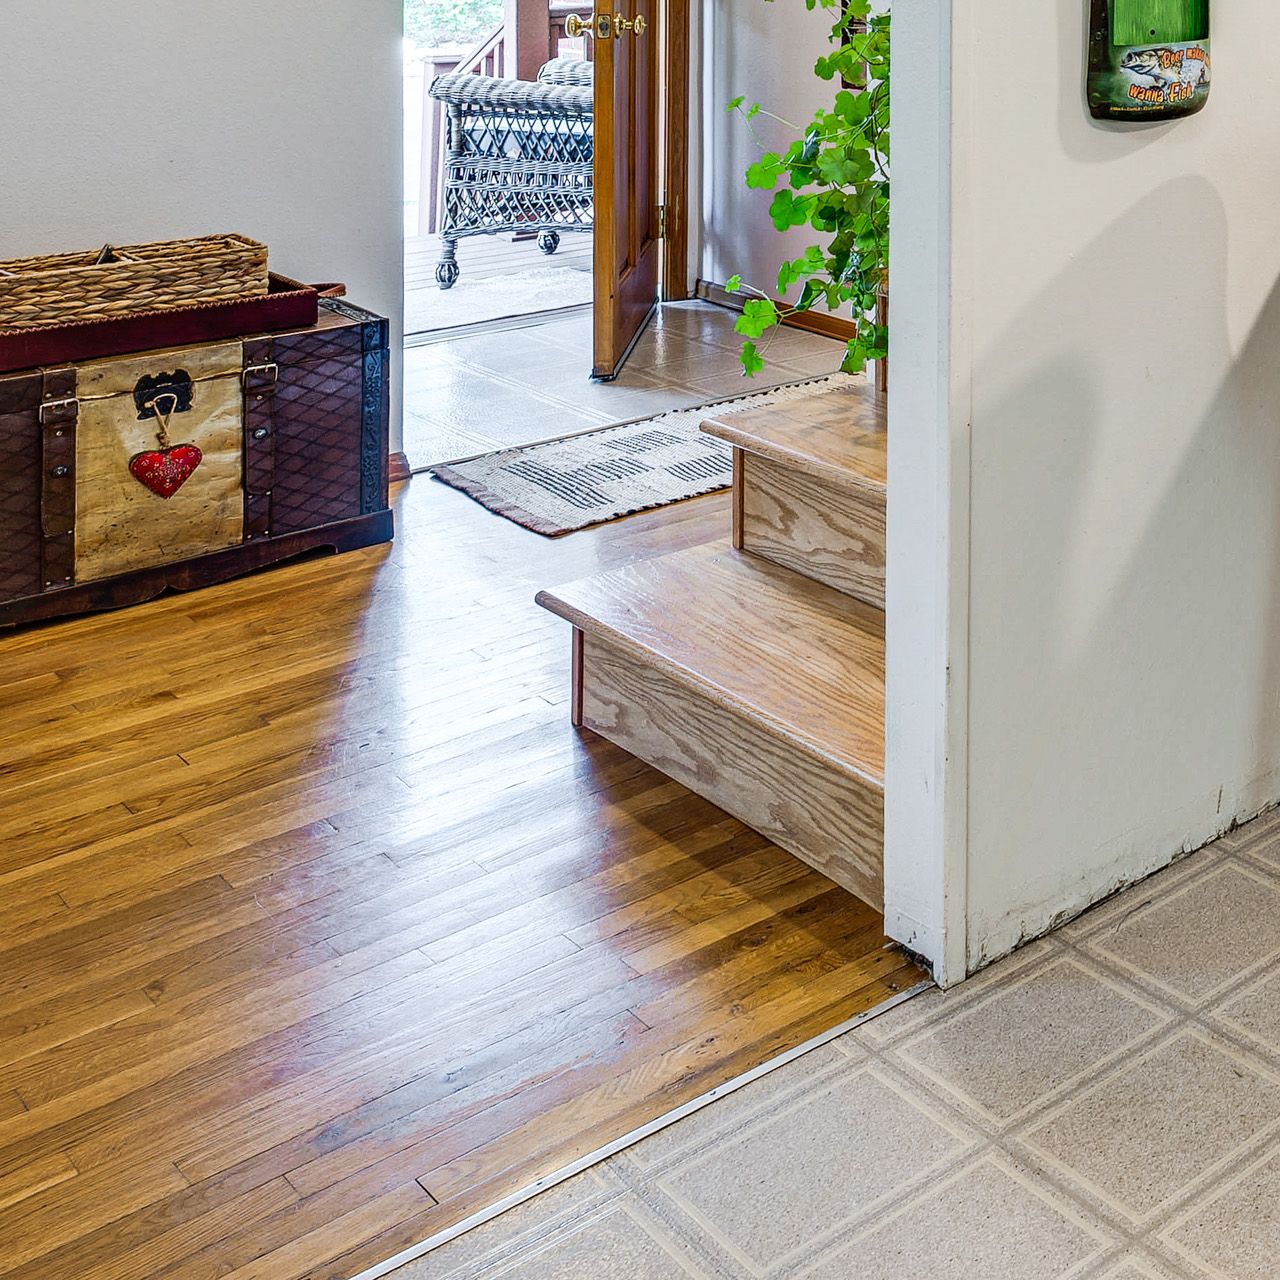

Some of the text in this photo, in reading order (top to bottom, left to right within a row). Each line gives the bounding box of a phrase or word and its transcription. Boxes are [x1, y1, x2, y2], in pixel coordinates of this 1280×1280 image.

[1161, 48, 1184, 69] Beer
[1128, 81, 1193, 104] wanna Fish
